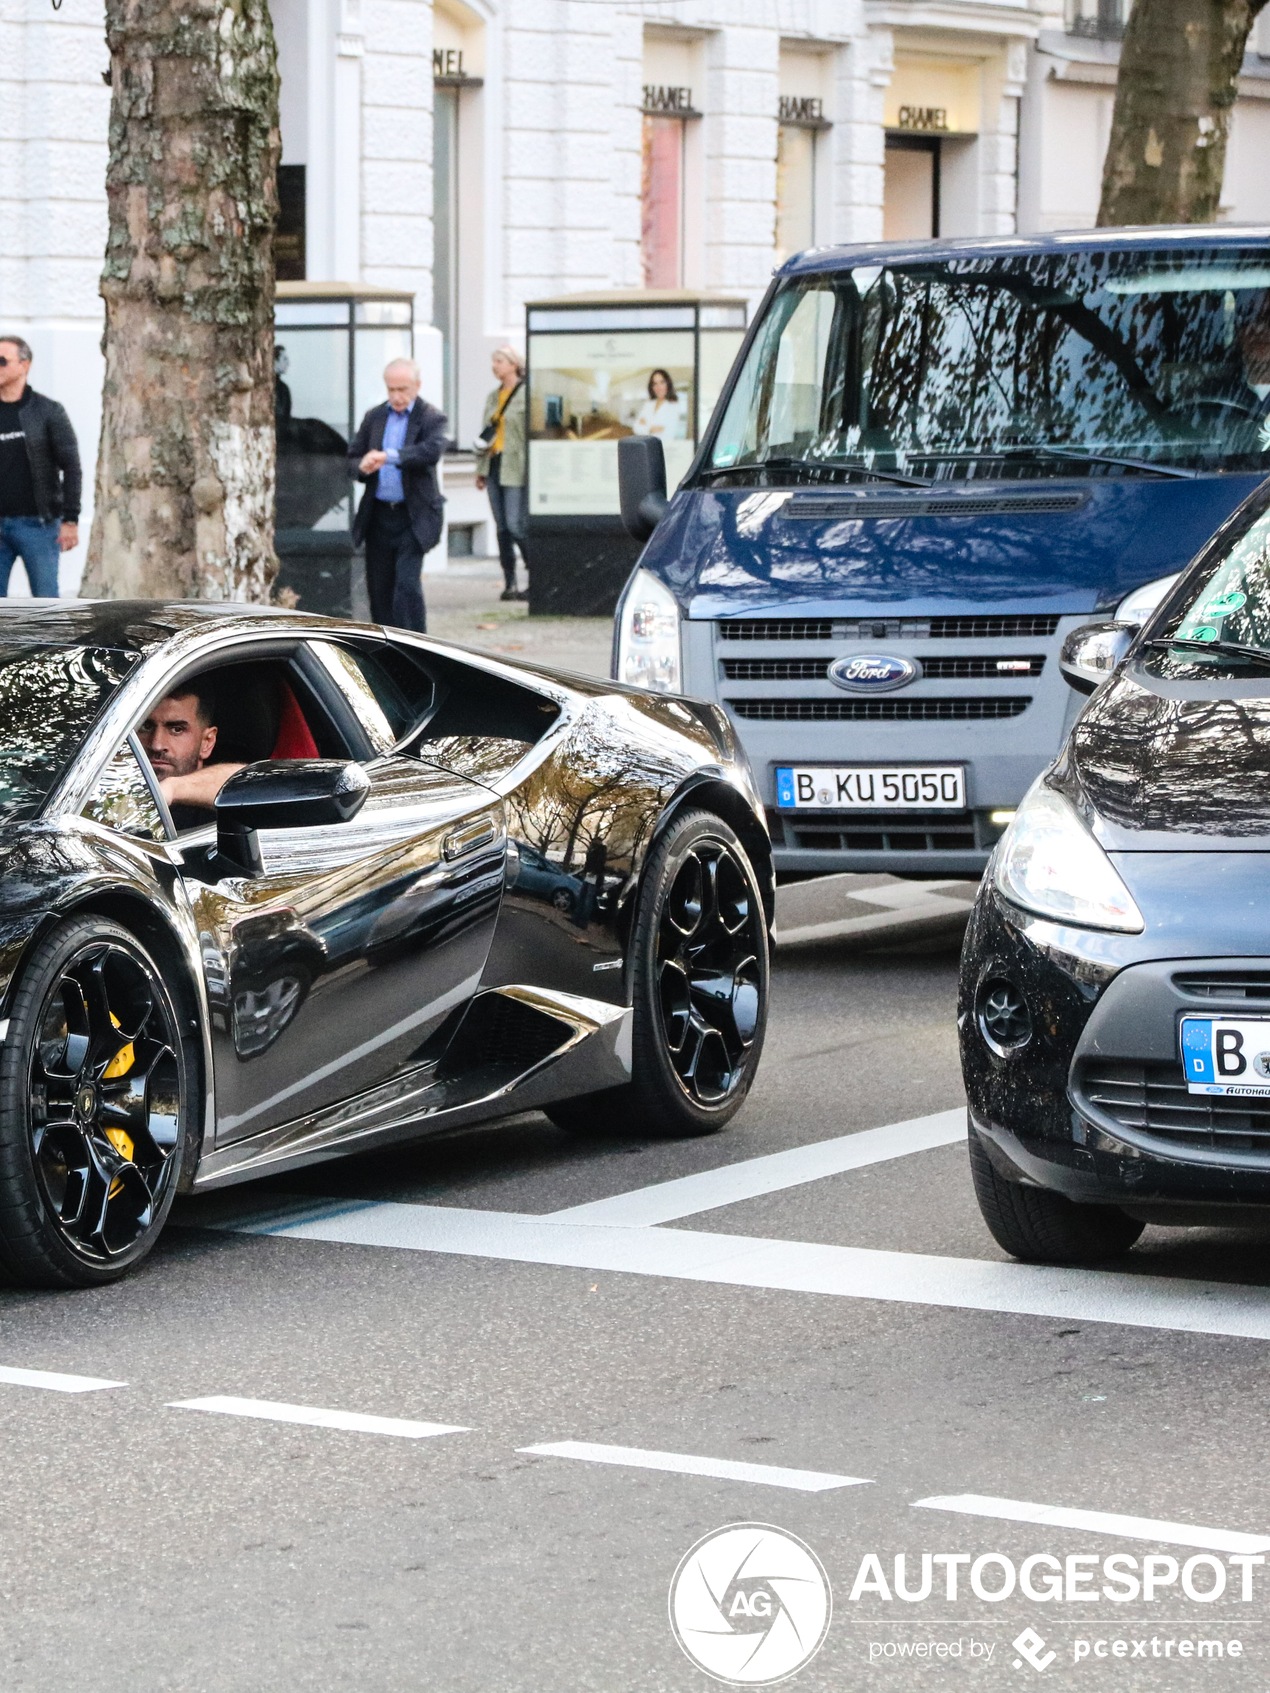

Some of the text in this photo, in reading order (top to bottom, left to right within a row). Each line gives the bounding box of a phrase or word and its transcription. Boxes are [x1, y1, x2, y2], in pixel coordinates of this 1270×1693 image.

[642, 86, 693, 110] HANEL
[898, 106, 948, 129] CHANEL
[846, 659, 892, 680] Ford
[783, 774, 958, 802] D B KU 5050
[1193, 1058, 1205, 1073] D
[1216, 1029, 1247, 1076] B
